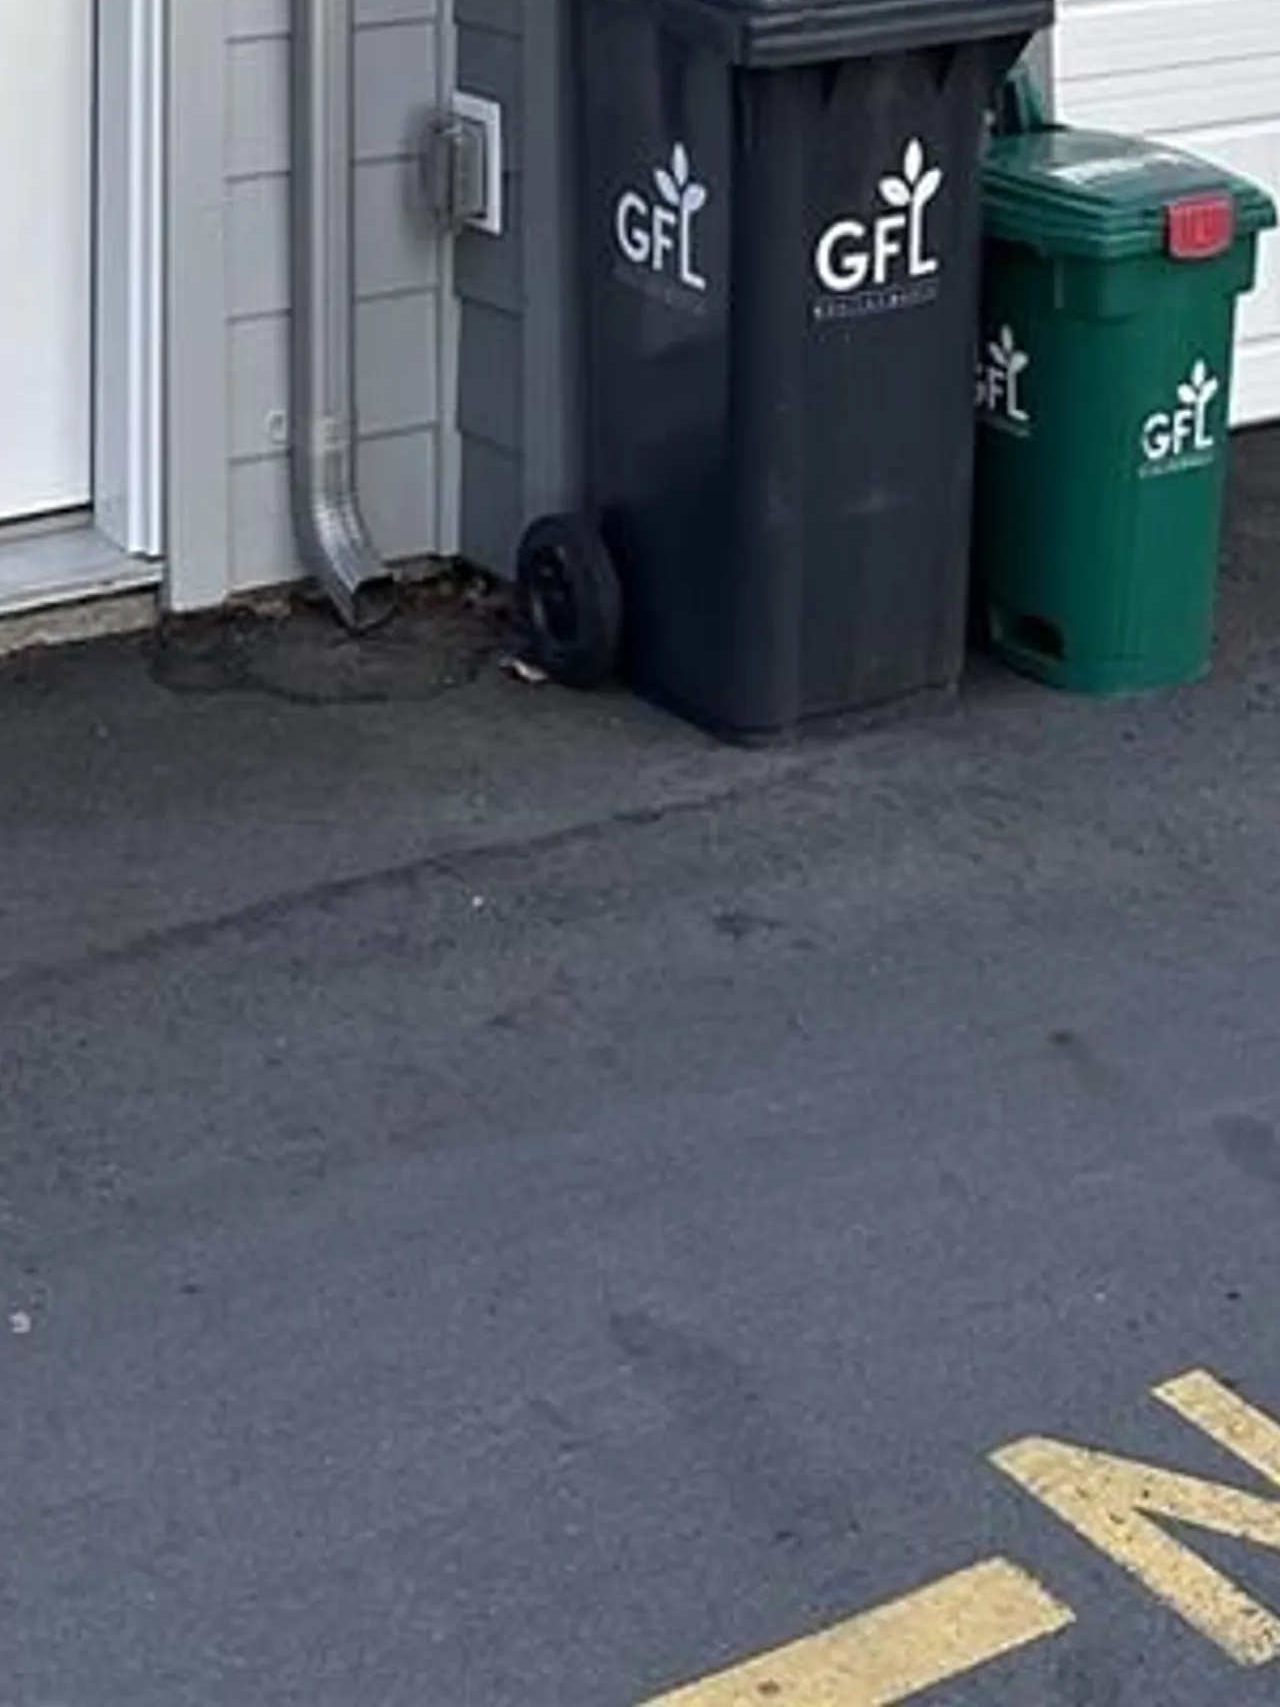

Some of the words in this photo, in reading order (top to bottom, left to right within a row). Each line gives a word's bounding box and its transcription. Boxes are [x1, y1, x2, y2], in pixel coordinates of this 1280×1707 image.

[617, 165, 707, 290] GFL
[816, 165, 942, 292] GFL
[1141, 373, 1219, 460] GFL
